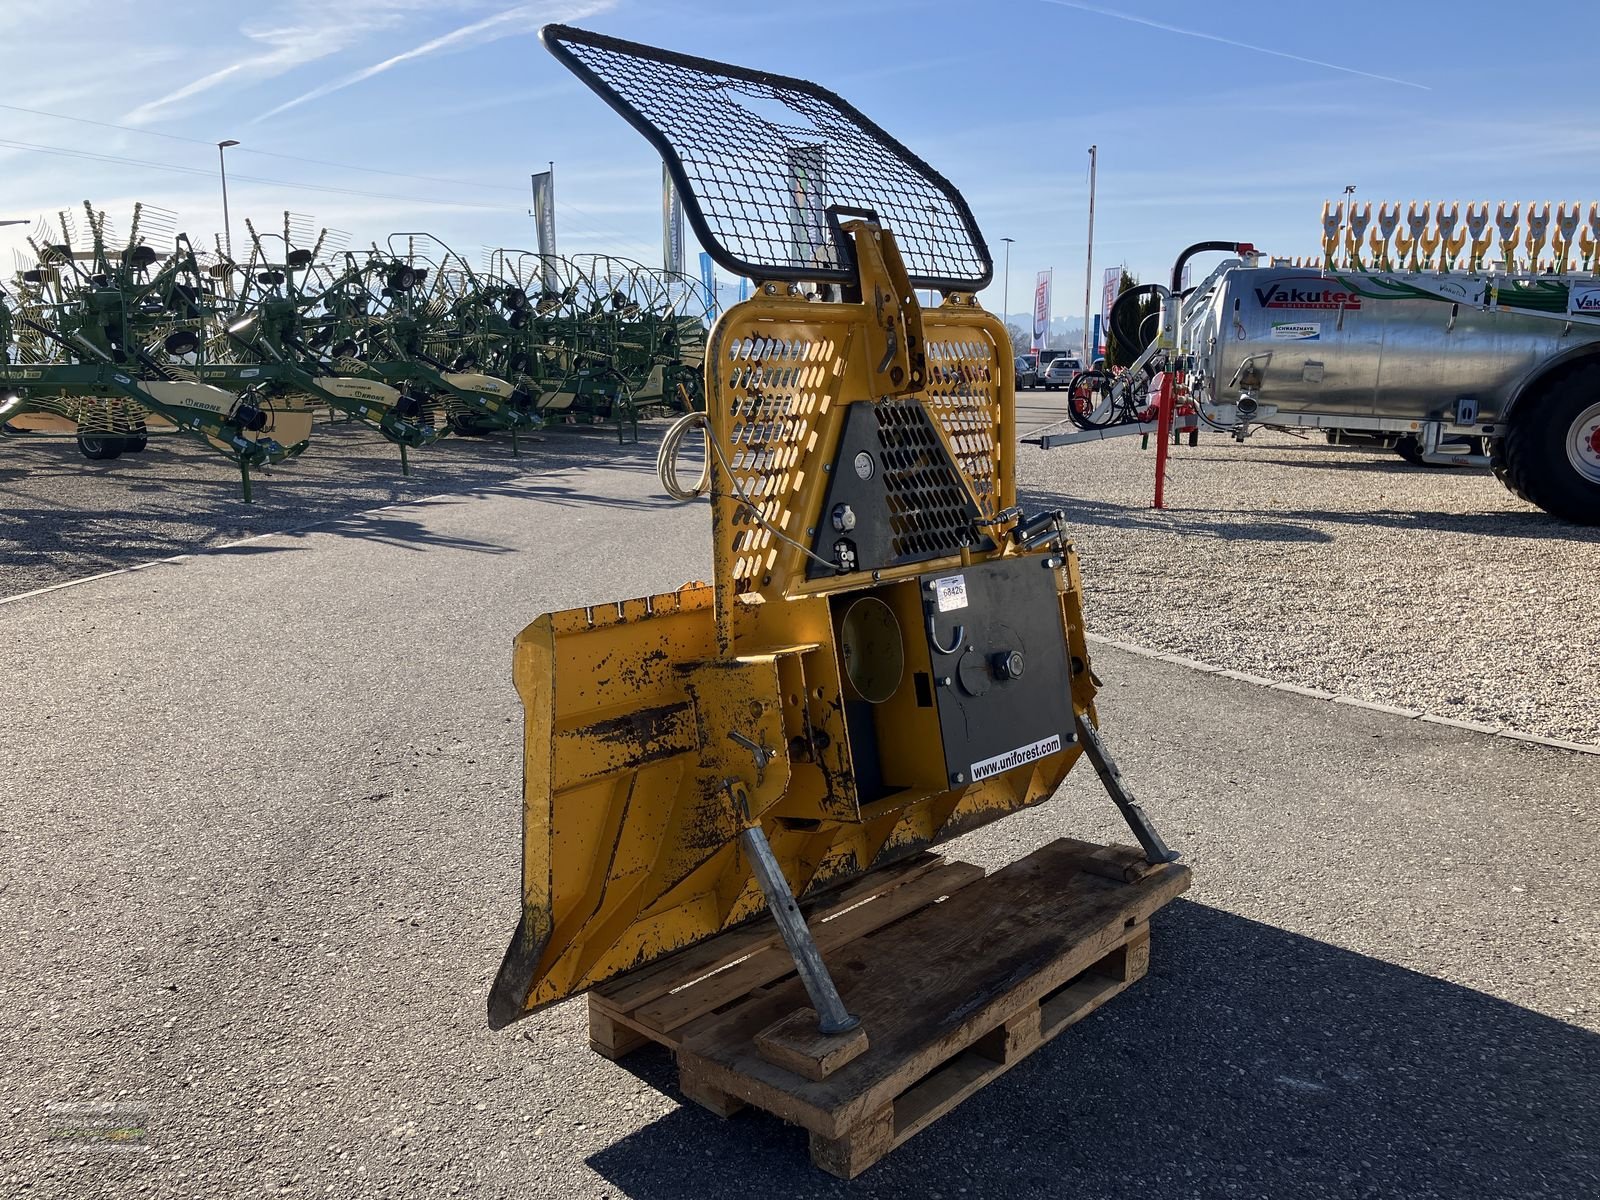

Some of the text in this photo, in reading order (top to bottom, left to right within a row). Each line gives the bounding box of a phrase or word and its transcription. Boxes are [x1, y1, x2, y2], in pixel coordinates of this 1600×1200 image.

[1255, 284, 1361, 308] Vakutec
[193, 401, 221, 411] KRONE
[973, 739, 1059, 778] www.uniforest.com
